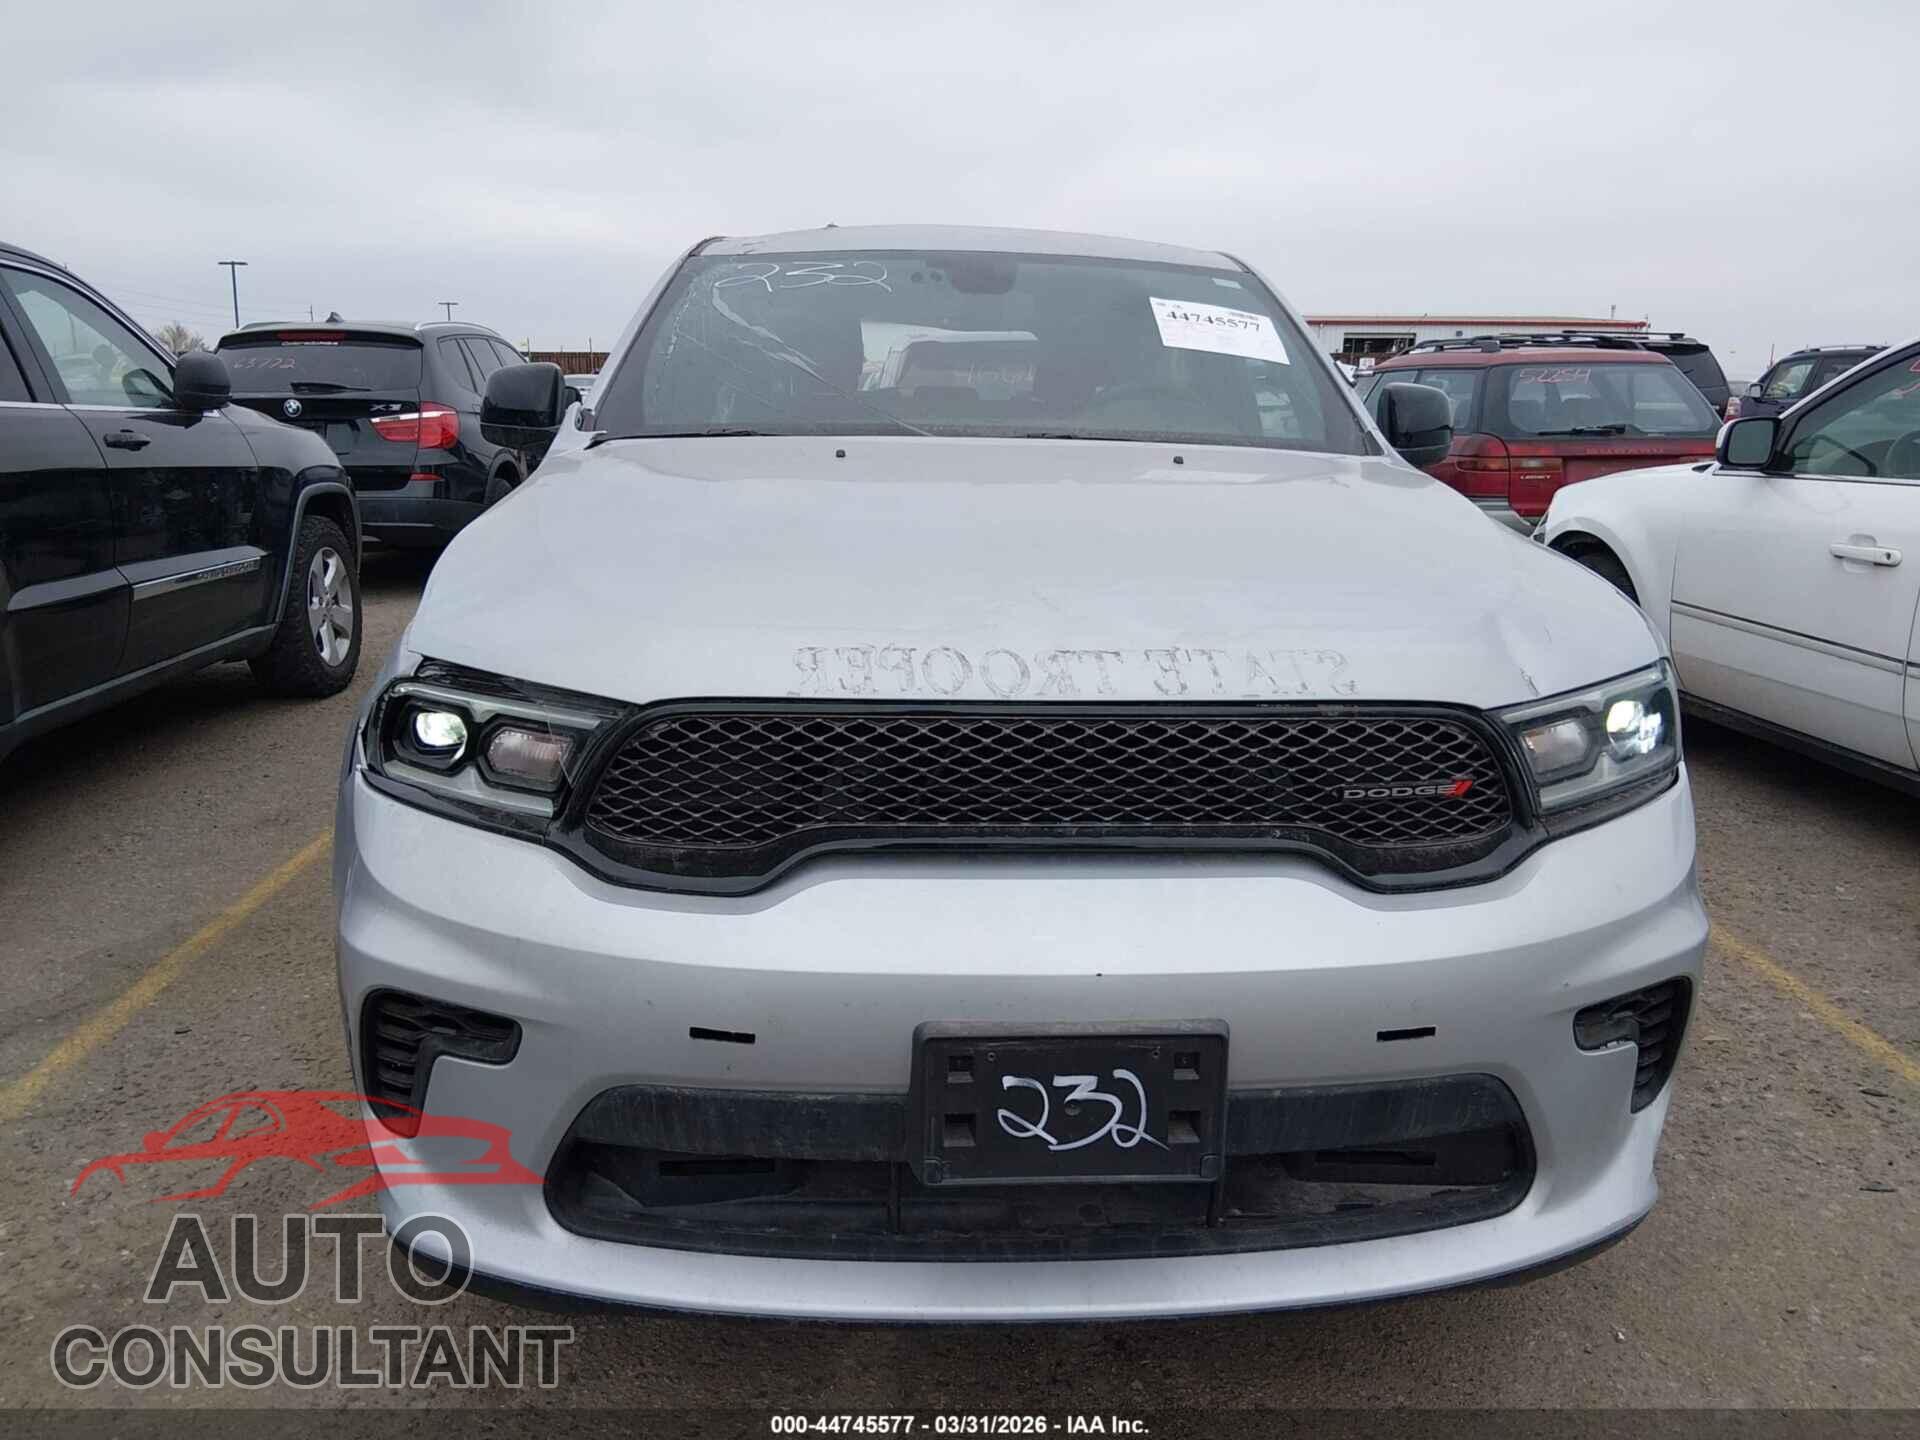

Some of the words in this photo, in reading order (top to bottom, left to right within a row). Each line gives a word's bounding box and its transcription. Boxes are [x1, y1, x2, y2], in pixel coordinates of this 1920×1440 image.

[1166, 310, 1260, 332] 44745577
[1343, 785, 1457, 799] DODGE
[997, 1068, 1170, 1152] 232
